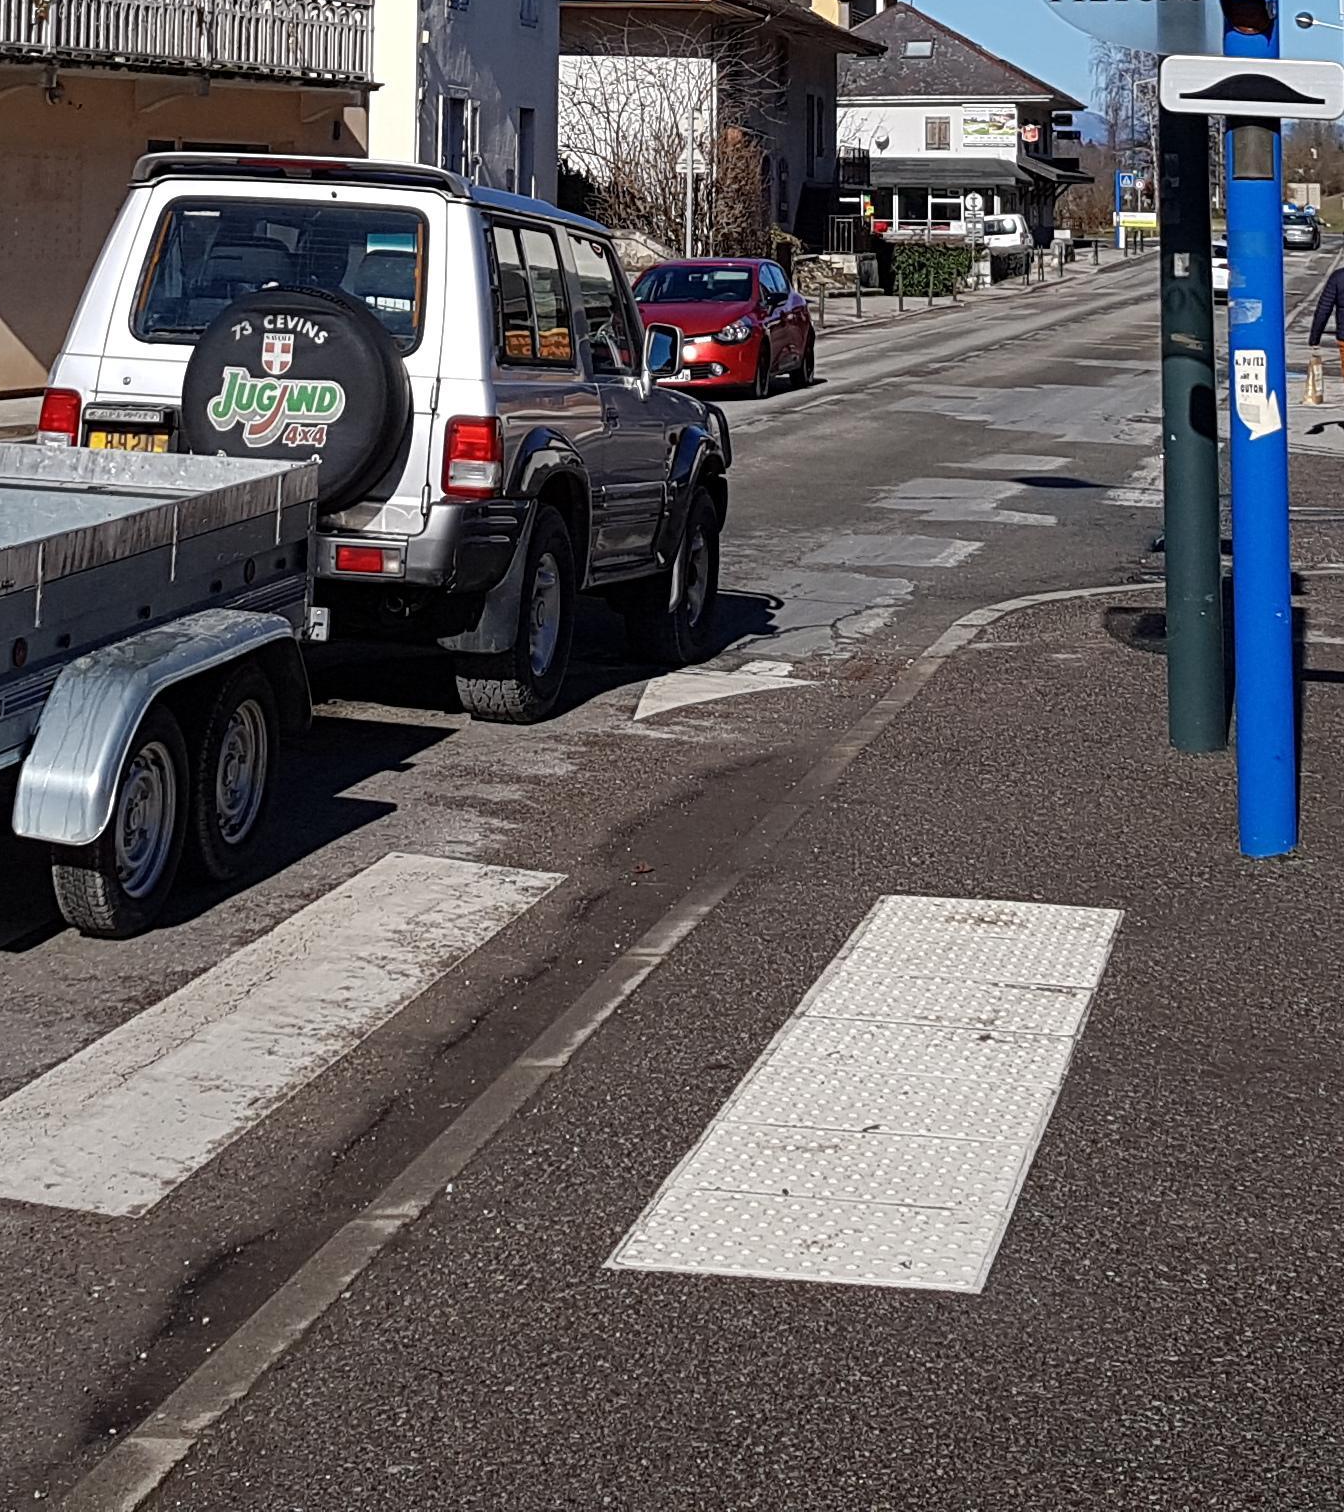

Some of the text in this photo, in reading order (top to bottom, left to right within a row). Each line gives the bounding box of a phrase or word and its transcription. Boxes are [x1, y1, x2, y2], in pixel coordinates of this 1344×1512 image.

[231, 314, 329, 344] 73 CEVINS
[282, 424, 328, 447] 4x4
